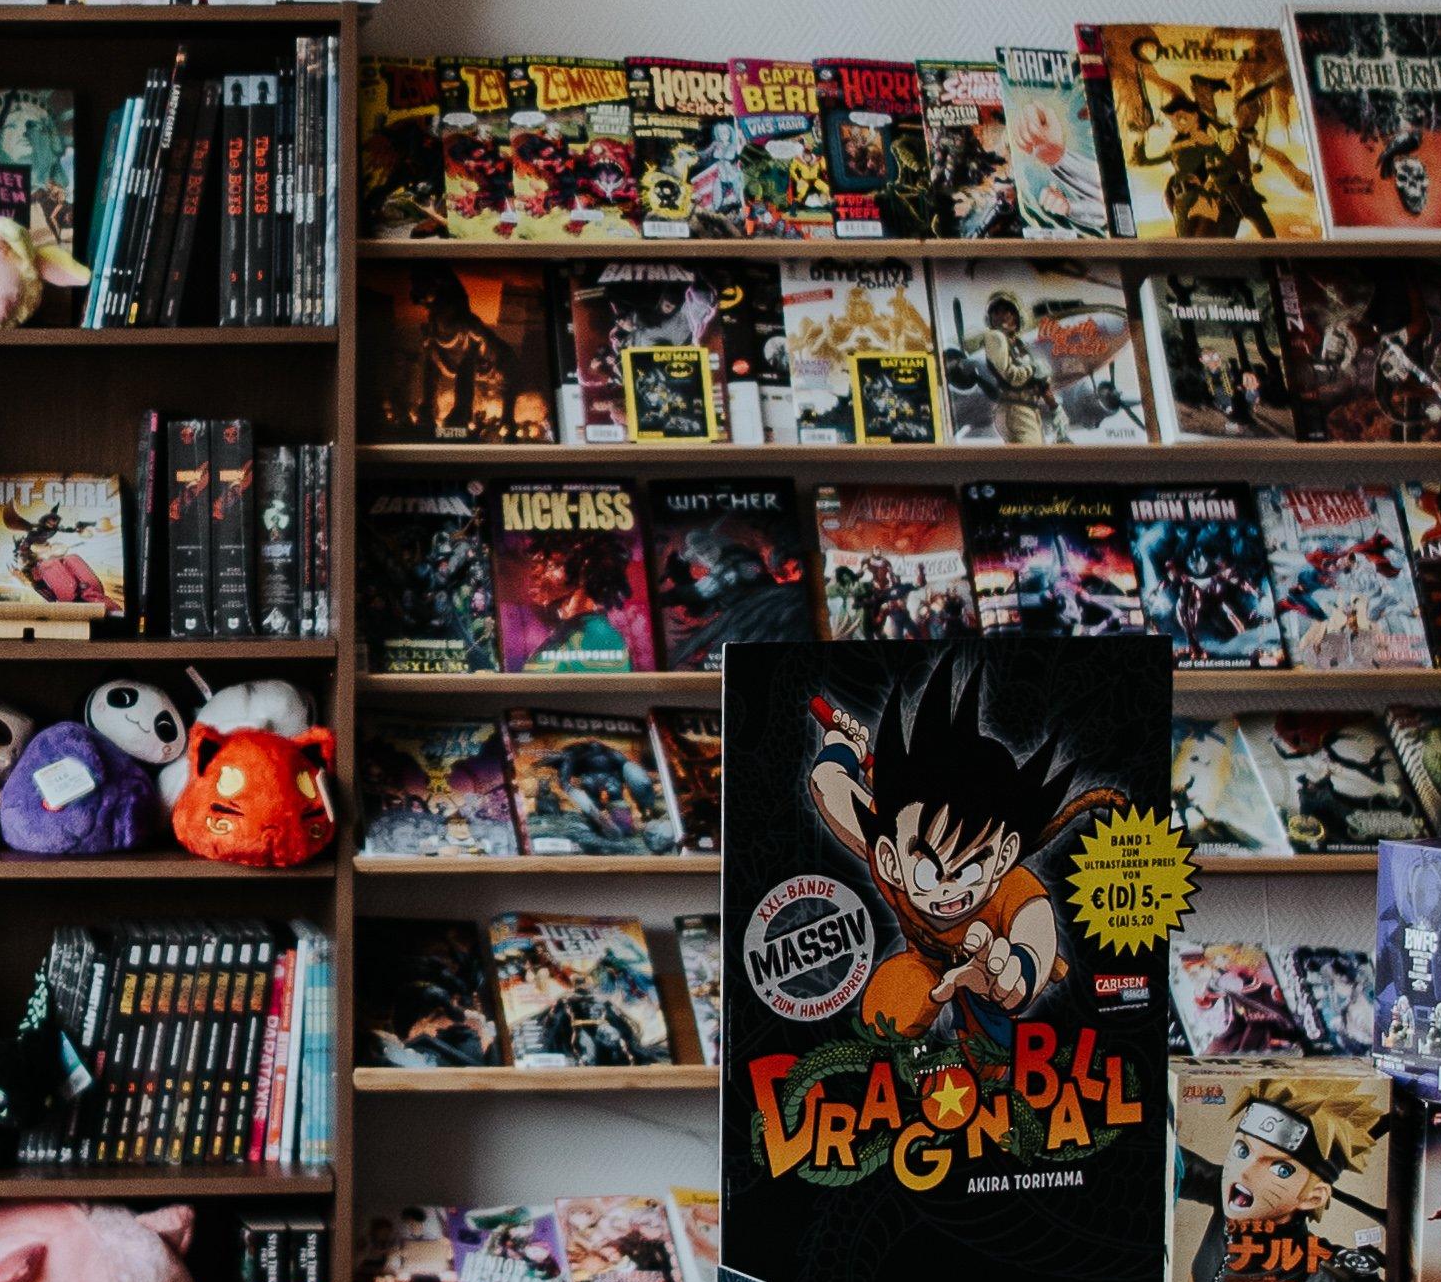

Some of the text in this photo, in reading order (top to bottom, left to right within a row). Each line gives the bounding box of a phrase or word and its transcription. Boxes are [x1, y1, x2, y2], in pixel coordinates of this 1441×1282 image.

[1324, 57, 1396, 88] REICHE
[228, 138, 244, 215] The BOYS
[254, 136, 269, 214] The BOYS
[653, 350, 698, 361] BATMAN
[880, 358, 925, 369] BATMAN
[503, 492, 634, 531] KICK-ASS
[667, 491, 780, 511] WITCHER
[1131, 500, 1185, 520] IRON
[537, 713, 642, 733] DEADPOOL
[1110, 834, 1141, 847] BAND
[1122, 848, 1140, 858] ZUM
[1151, 857, 1176, 868] PREIS
[1123, 870, 1141, 880] VON
[758, 878, 836, 923] XXL-BÄNDE
[749, 907, 868, 985] MASSIV
[1405, 928, 1439, 953] BWFC
[771, 962, 869, 1018] ZUM HAMMERPREIS
[1095, 976, 1146, 994] CARLSEN
[966, 1170, 1085, 1195] AKIRA TORIYAMA
[1226, 1235, 1332, 1274] ナルト
